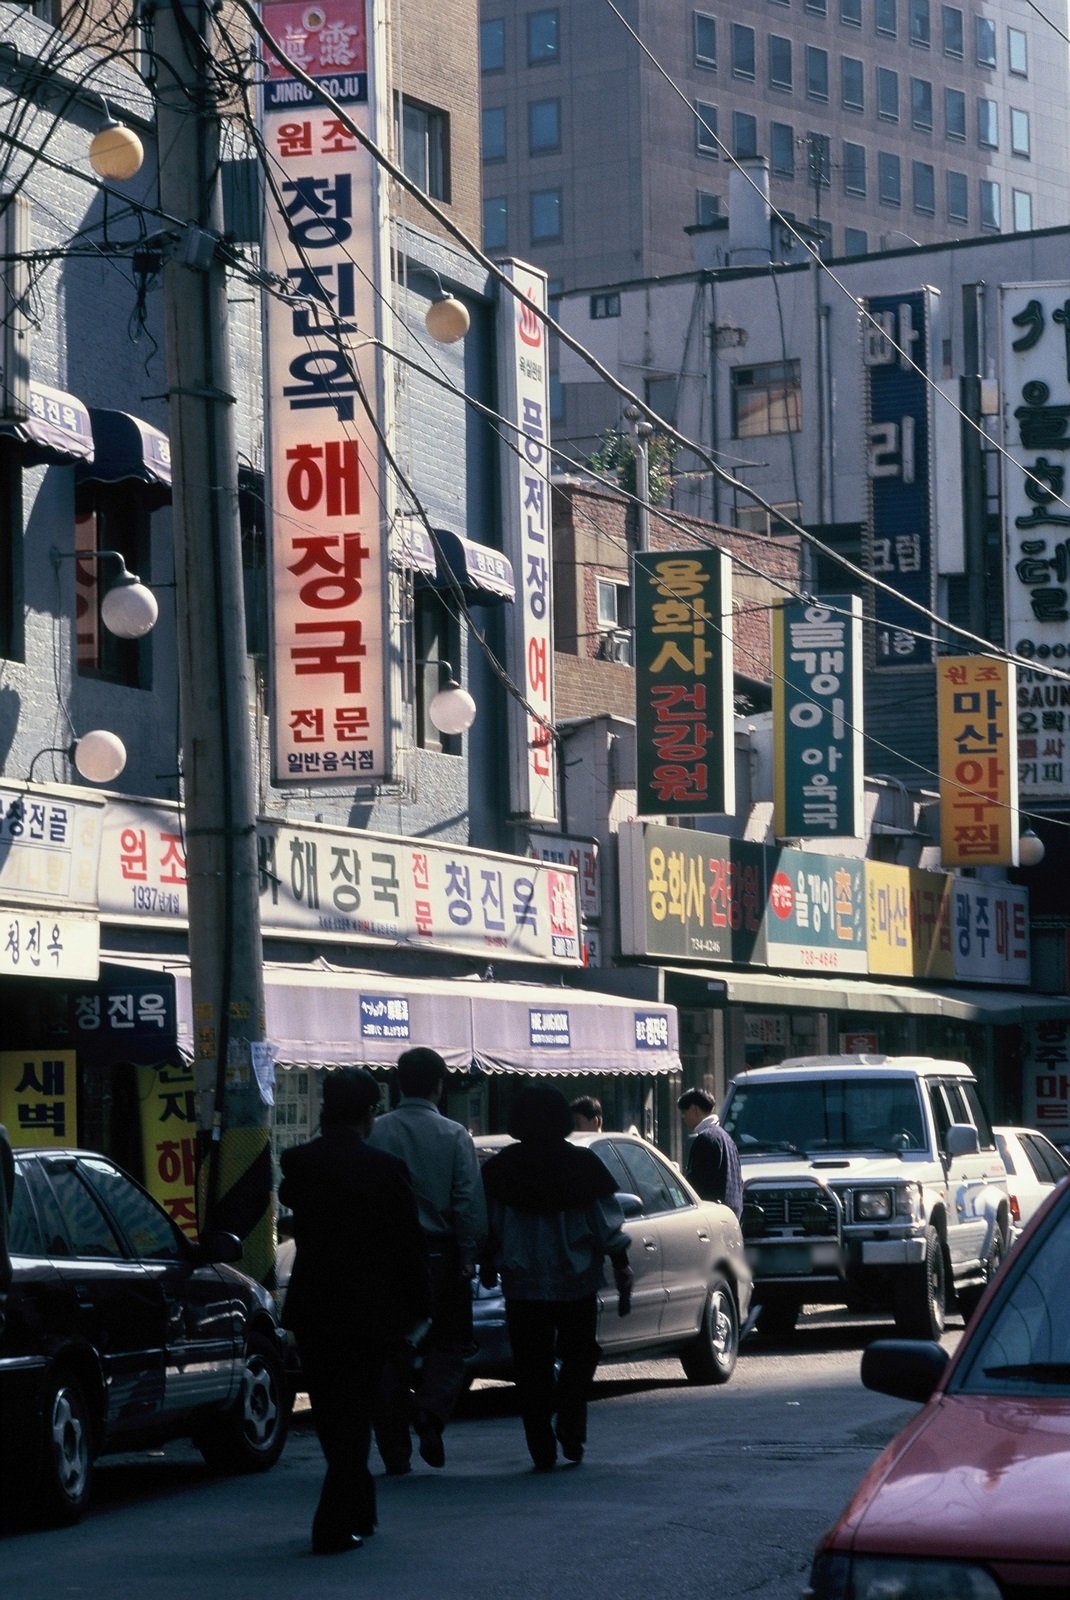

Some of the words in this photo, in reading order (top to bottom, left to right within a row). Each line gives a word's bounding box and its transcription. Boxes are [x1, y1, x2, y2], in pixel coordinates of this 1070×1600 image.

[277, 119, 357, 157] 원조
[279, 174, 358, 422] 청진옥
[286, 440, 370, 694] 해장국
[649, 559, 713, 676] 용화사
[790, 604, 846, 740] 올갱이
[944, 665, 1002, 685] 원조
[289, 706, 370, 743] 전문
[650, 683, 714, 801] 건강원
[953, 689, 1003, 755] 마산
[287, 750, 374, 774] 일반음식점
[801, 746, 843, 830] 아욱국
[953, 756, 1004, 857] 아구찜
[120, 828, 188, 886] 원조
[411, 852, 434, 937] 전문
[445, 860, 538, 937] 청진옥
[649, 846, 706, 928] 용화사
[5, 919, 64, 968] 청진옥
[877, 883, 908, 948] 마산
[75, 993, 167, 1031] 청진옥
[14, 1060, 66, 1137] 새벽
